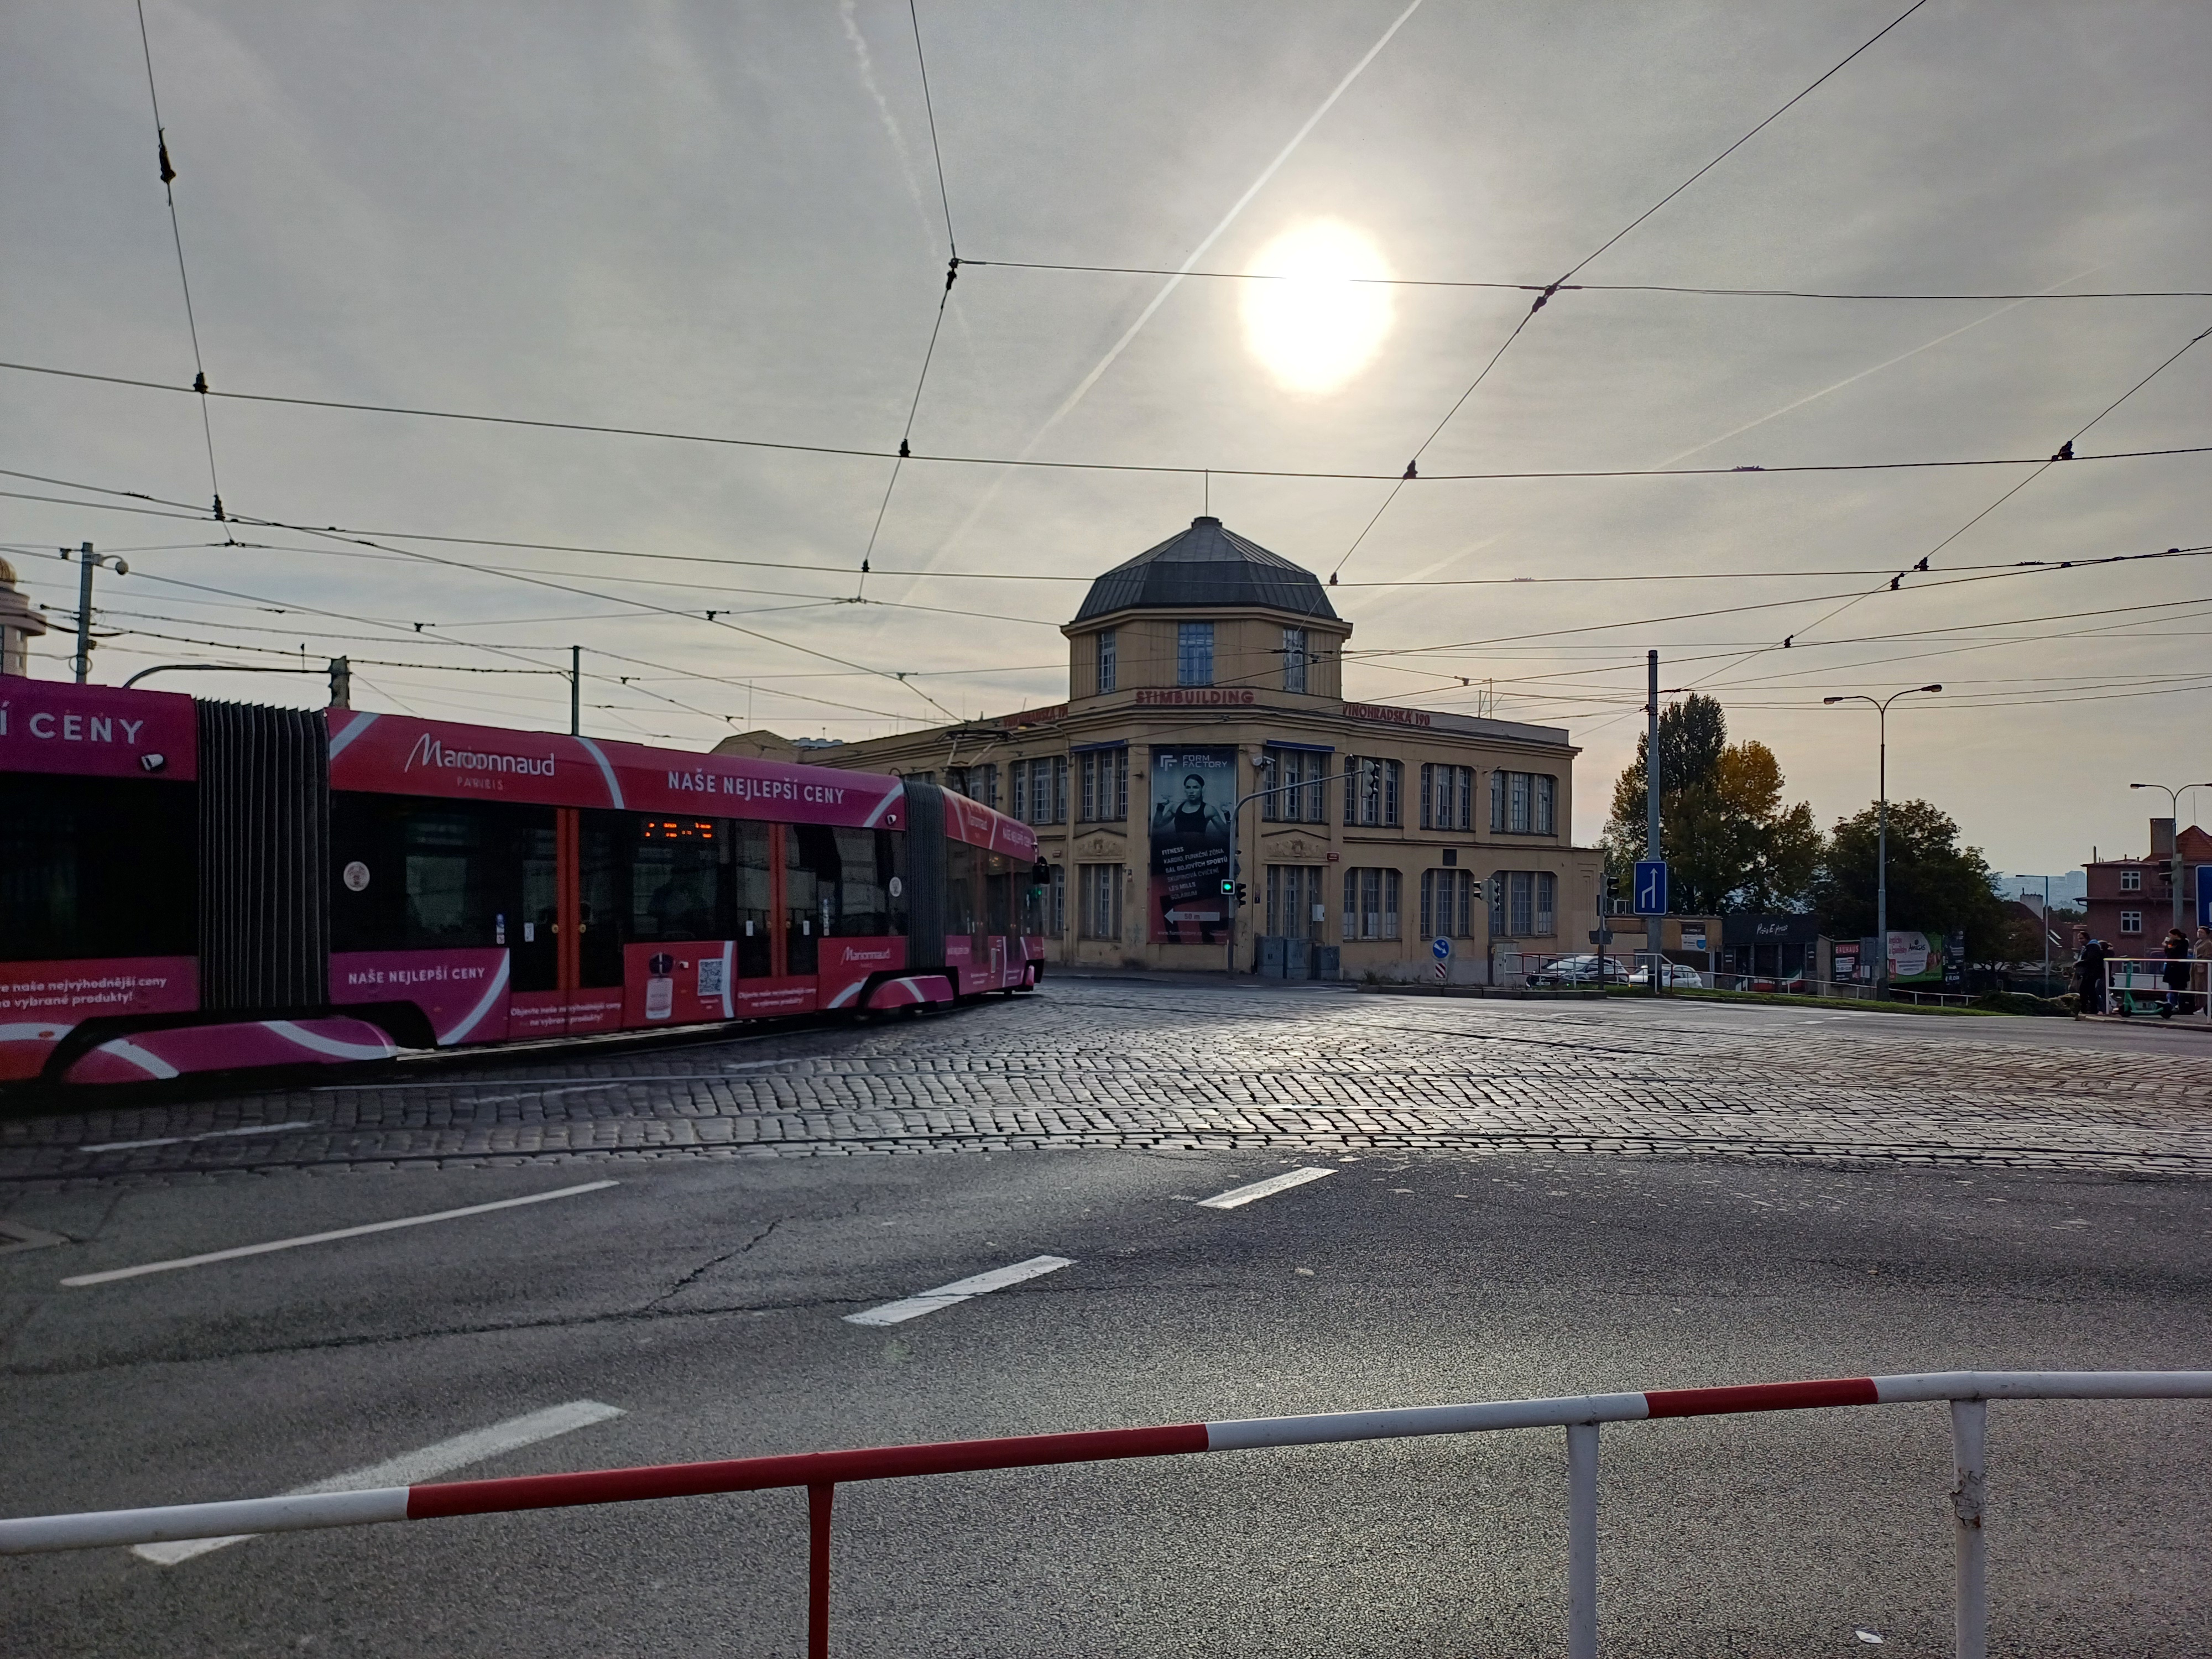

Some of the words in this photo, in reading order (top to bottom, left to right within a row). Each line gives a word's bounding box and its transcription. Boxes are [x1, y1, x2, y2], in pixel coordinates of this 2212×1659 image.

[1136, 691, 1254, 703] STIMBUILDING
[1343, 704, 1413, 724] VINOHRADSKÁ
[1415, 713, 1430, 726] 190
[29, 712, 144, 744] CENY
[668, 768, 716, 792] NAŠE
[723, 777, 797, 801] NEJLEPŠÍ
[804, 785, 844, 804] CENY
[1162, 847, 1184, 855] FITNESS
[1835, 945, 1859, 954] BAUHAUS
[138, 978, 167, 991] ceny
[348, 968, 384, 985] NAŠE
[389, 967, 447, 986] NEJLEPŠÍ
[452, 967, 486, 980] CENY
